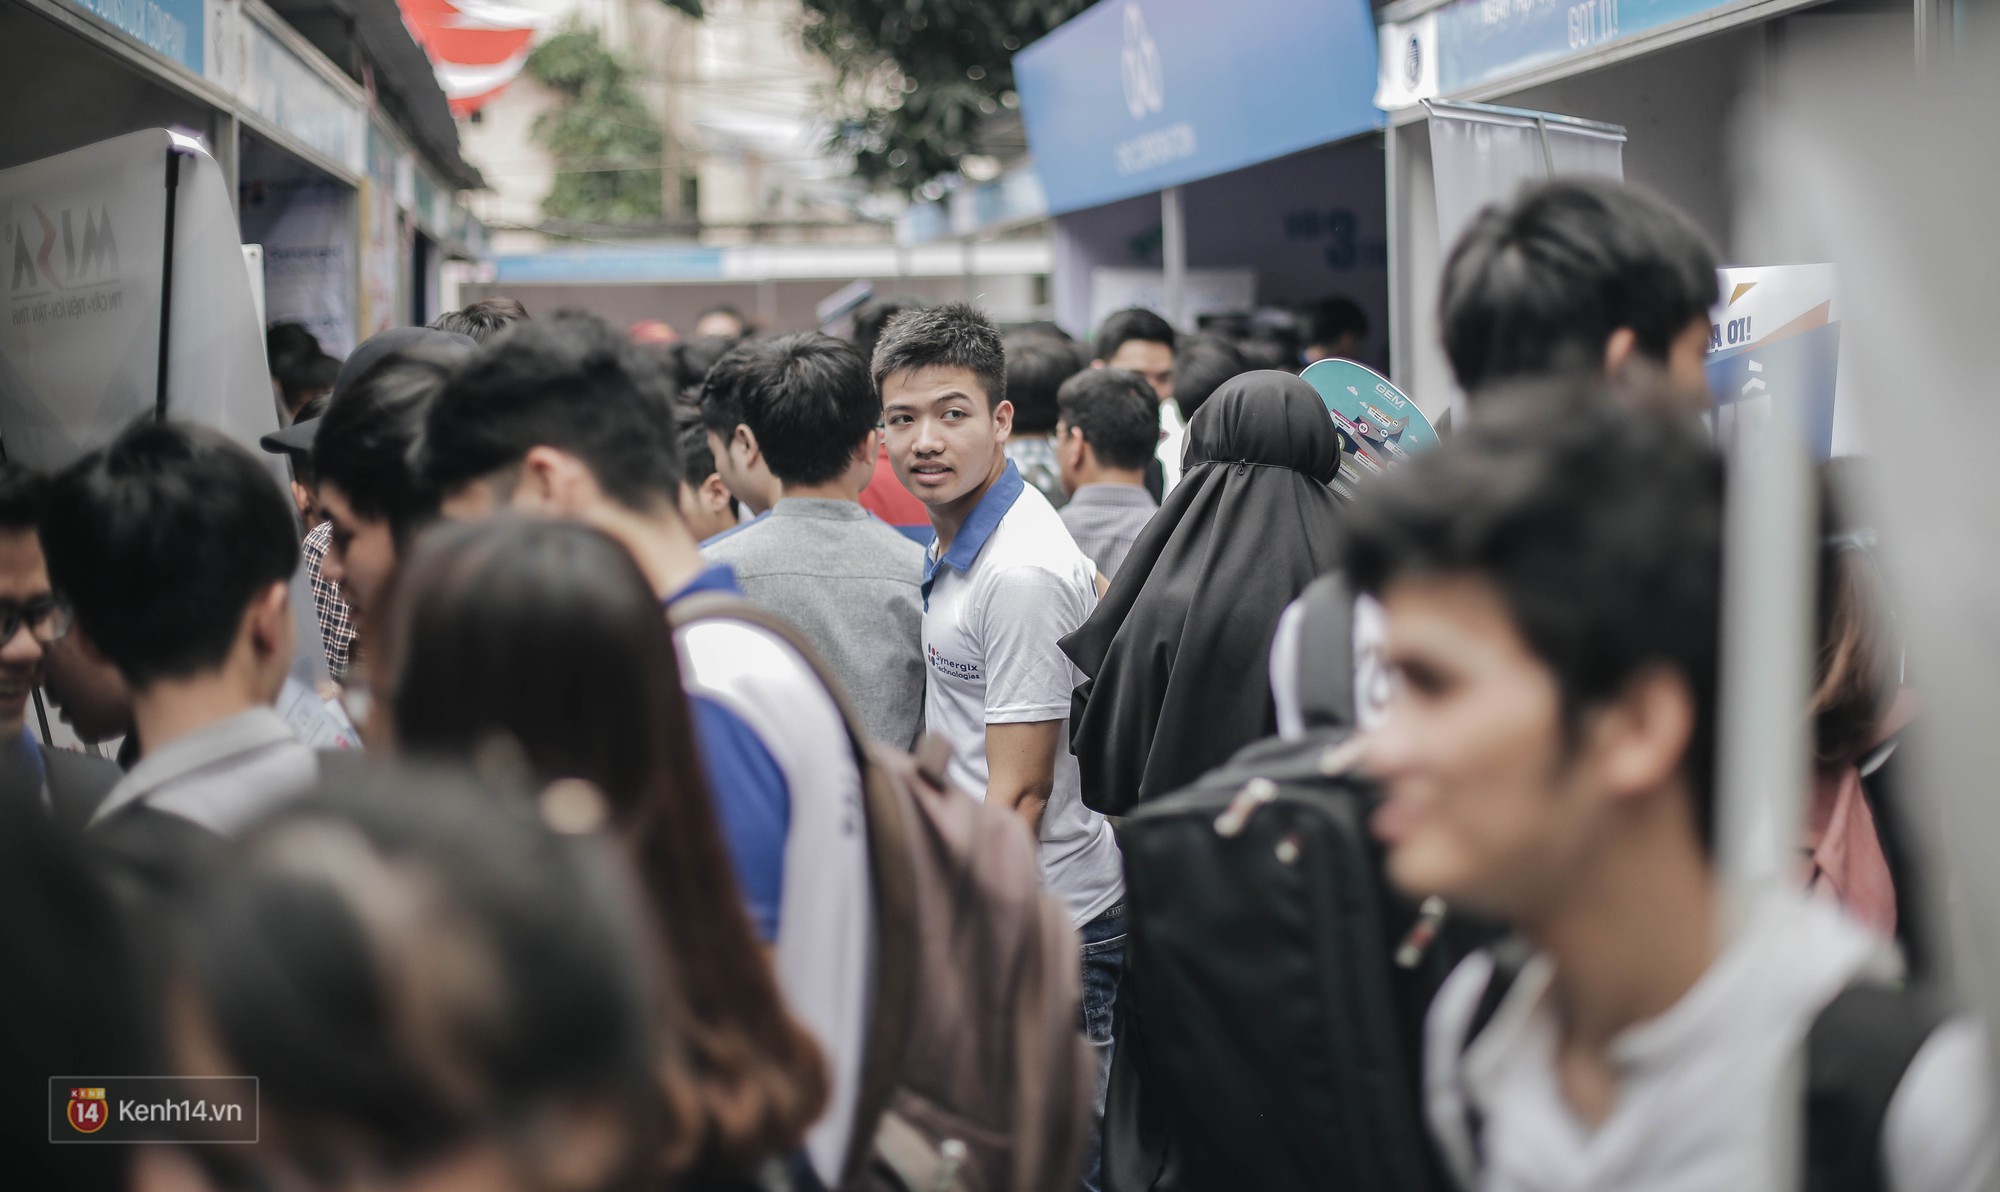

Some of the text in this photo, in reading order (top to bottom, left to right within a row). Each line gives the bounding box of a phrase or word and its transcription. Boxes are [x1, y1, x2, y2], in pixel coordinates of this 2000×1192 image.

[1375, 383, 1406, 408] GEM
[936, 651, 978, 672] Synergix
[936, 662, 980, 680] Technologies
